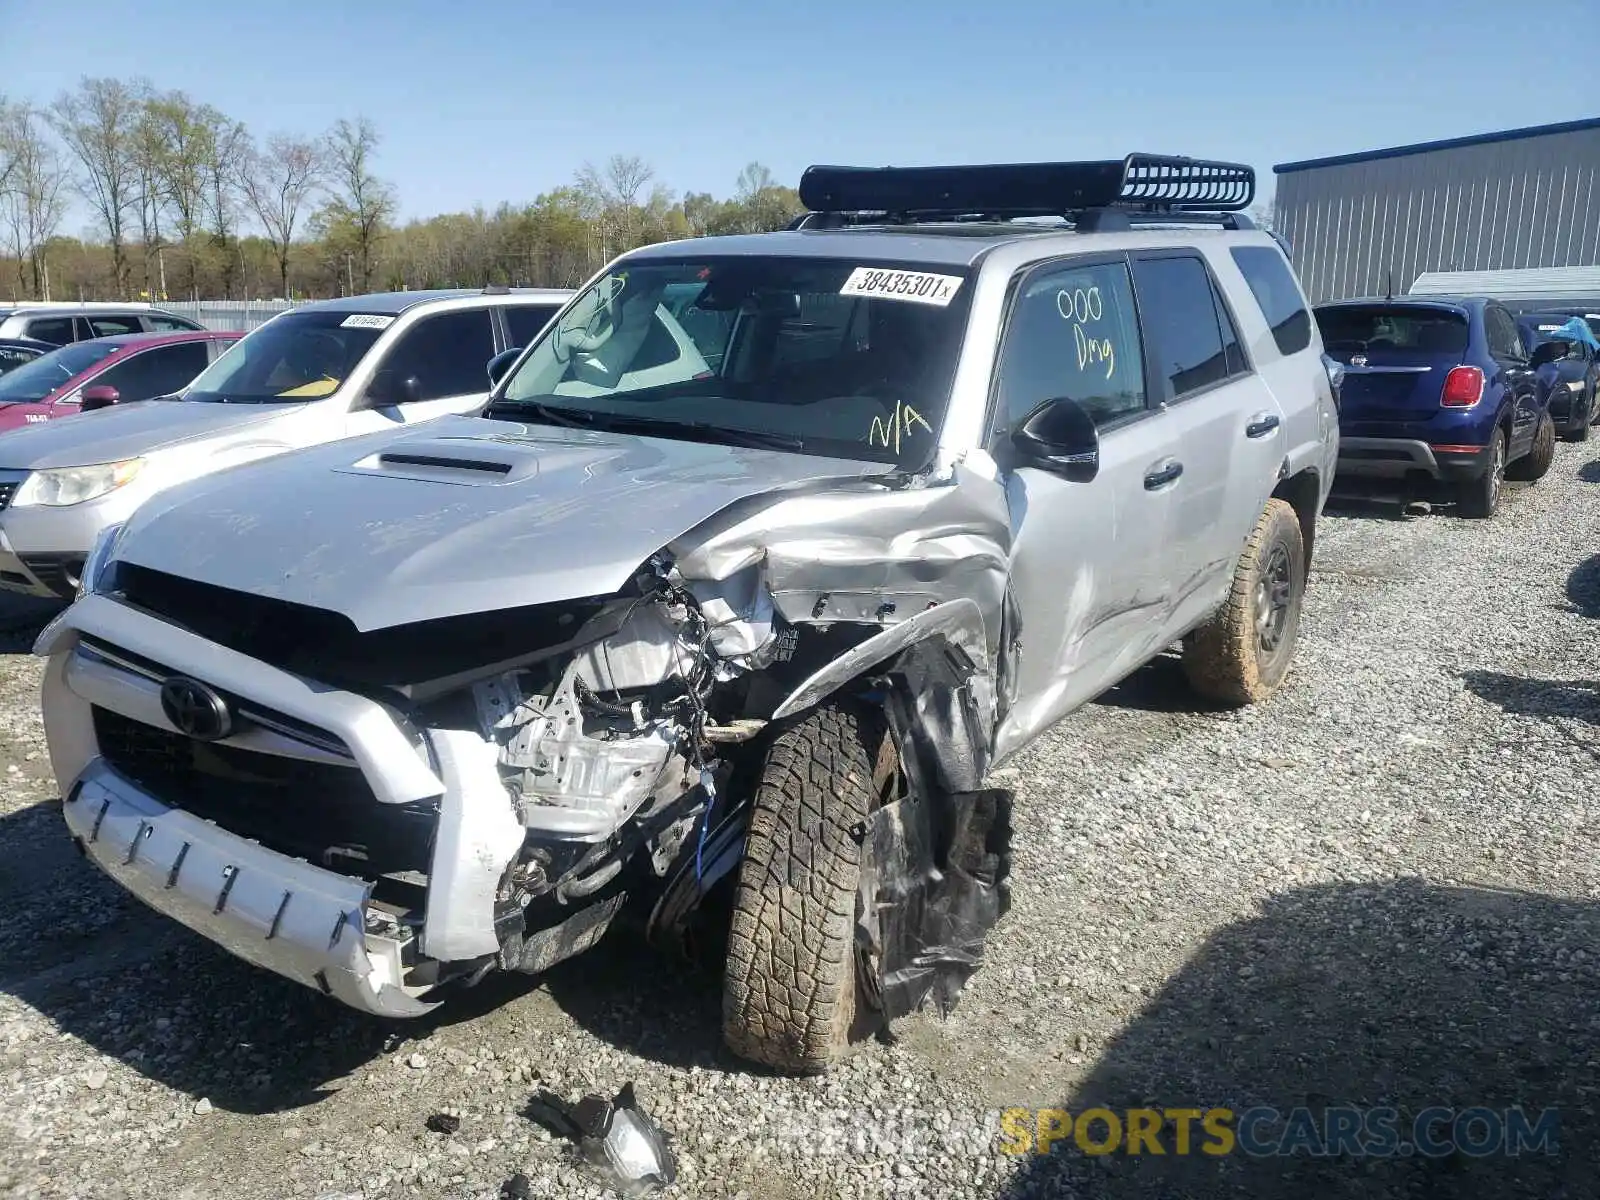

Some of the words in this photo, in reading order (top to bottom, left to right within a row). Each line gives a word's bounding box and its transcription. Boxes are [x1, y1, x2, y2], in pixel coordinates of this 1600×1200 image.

[857, 271, 944, 298] 38435301
[1073, 323, 1114, 380] Dmg
[869, 400, 933, 456] N/A
